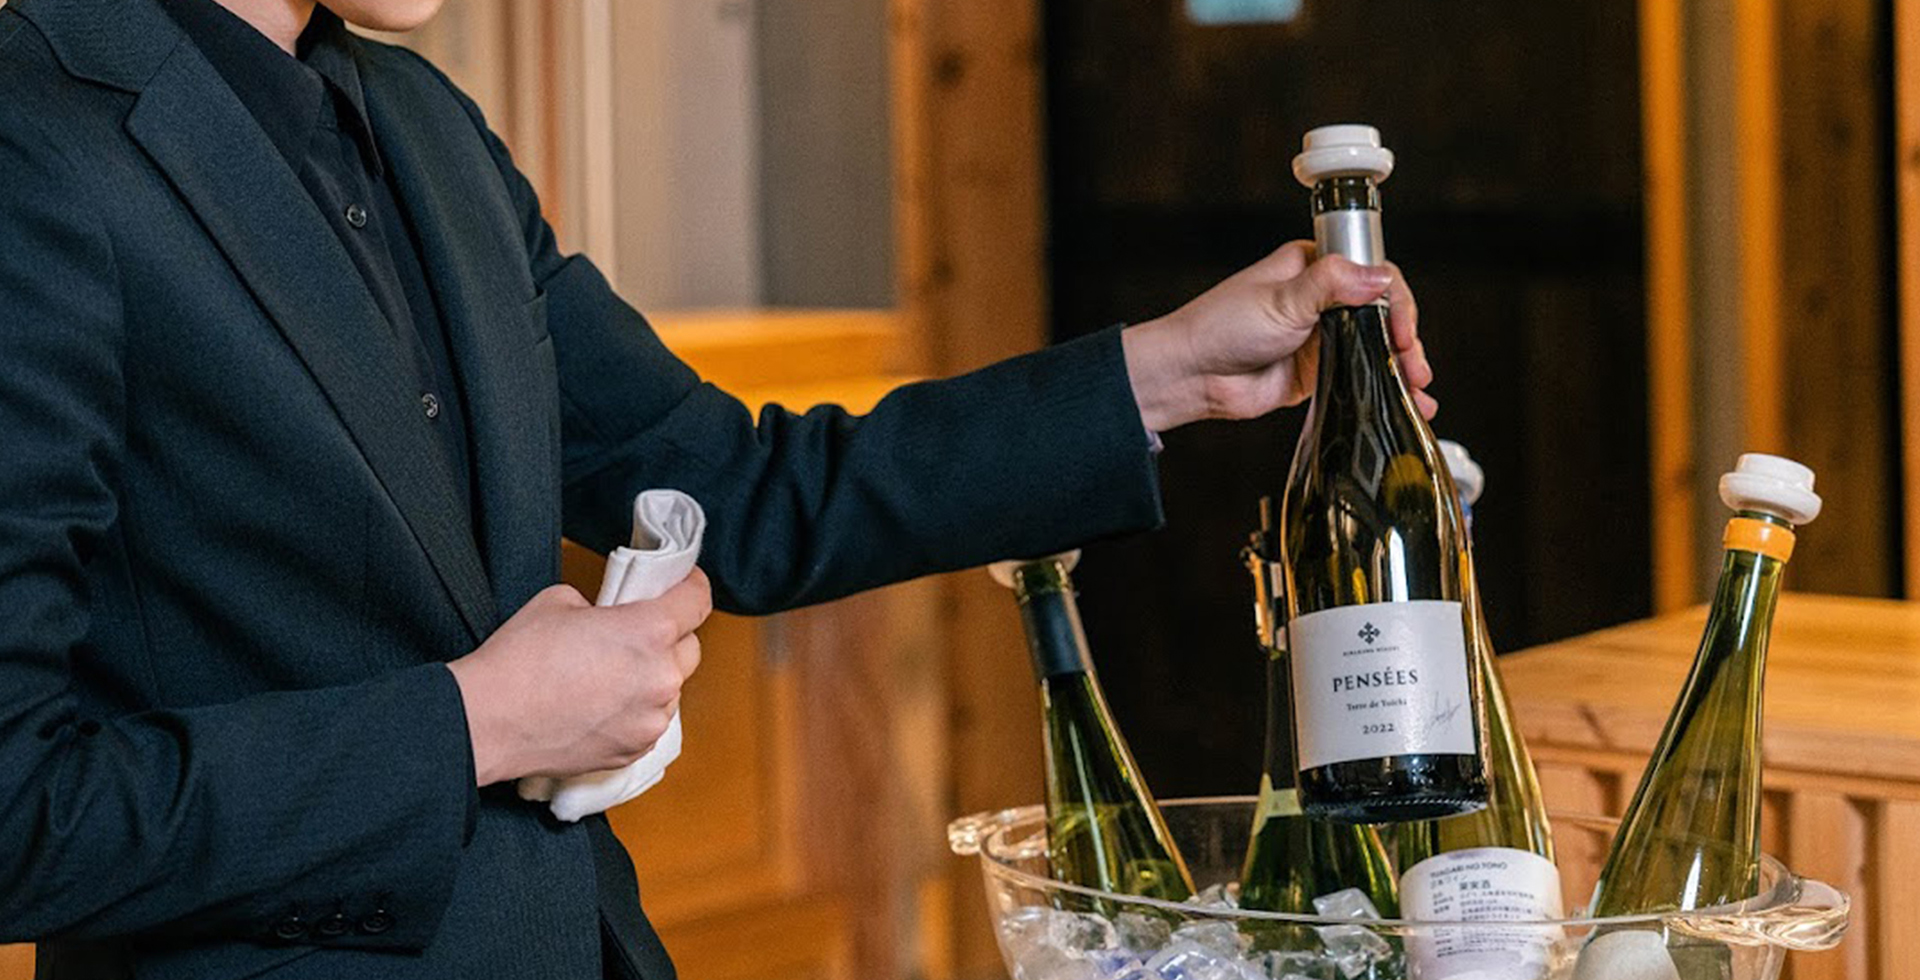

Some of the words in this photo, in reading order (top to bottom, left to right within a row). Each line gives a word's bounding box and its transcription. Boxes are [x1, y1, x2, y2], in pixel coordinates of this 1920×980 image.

[1333, 666, 1418, 692] PENSÉES
[1369, 700, 1379, 708] de
[1362, 723, 1395, 735] 2022
